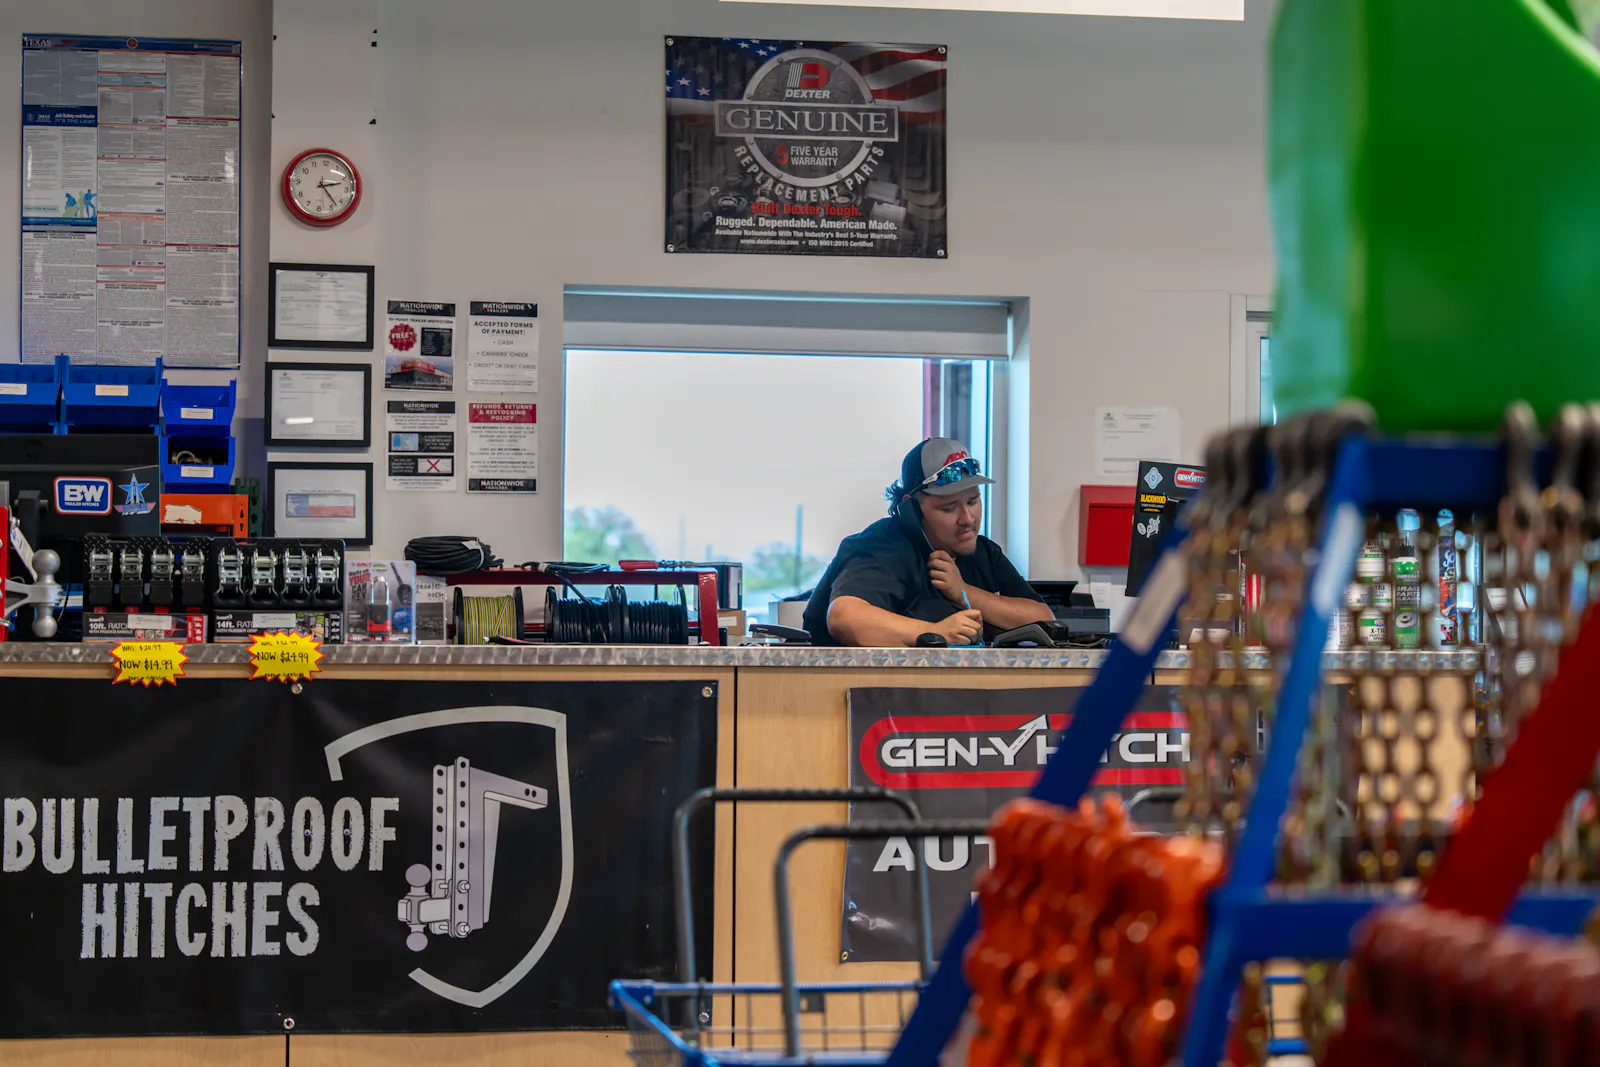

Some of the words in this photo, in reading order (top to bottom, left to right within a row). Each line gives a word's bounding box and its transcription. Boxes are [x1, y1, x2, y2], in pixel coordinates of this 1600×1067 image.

[24, 38, 52, 47] TEXAS
[785, 88, 831, 99] DEXTER
[726, 108, 889, 133] GENUINE
[777, 145, 789, 165] 5
[790, 146, 813, 157] FIVE
[813, 146, 838, 157] YEAR
[790, 156, 838, 166] WARRANTY
[734, 145, 839, 202] REPLACEMENT
[845, 146, 884, 190] PARTS
[752, 202, 780, 214] Built
[783, 203, 820, 215] Dexter
[824, 203, 863, 219] Tough.
[715, 215, 756, 228] Rugged.
[758, 217, 818, 229] Dependable.
[820, 219, 866, 229] American
[868, 219, 898, 230] Made.
[743, 229, 777, 237] Nationwide
[804, 231, 834, 239] Industry's
[870, 232, 898, 240] Warranty.
[400, 302, 444, 310] NATIONWIDE
[349, 572, 371, 587] YOUR
[352, 583, 367, 593] CAR
[89, 622, 107, 630] 10ft.
[217, 620, 235, 628] 14ft.
[257, 651, 279, 661] NOW:
[280, 650, 309, 664] $24.99
[119, 660, 143, 670] NOW:
[144, 658, 173, 671] $14.99
[881, 716, 1047, 768] GEN-Y
[1036, 732, 1191, 765] HCH
[2, 795, 400, 874] BULLETPROOF
[80, 882, 321, 959] HITCHES
